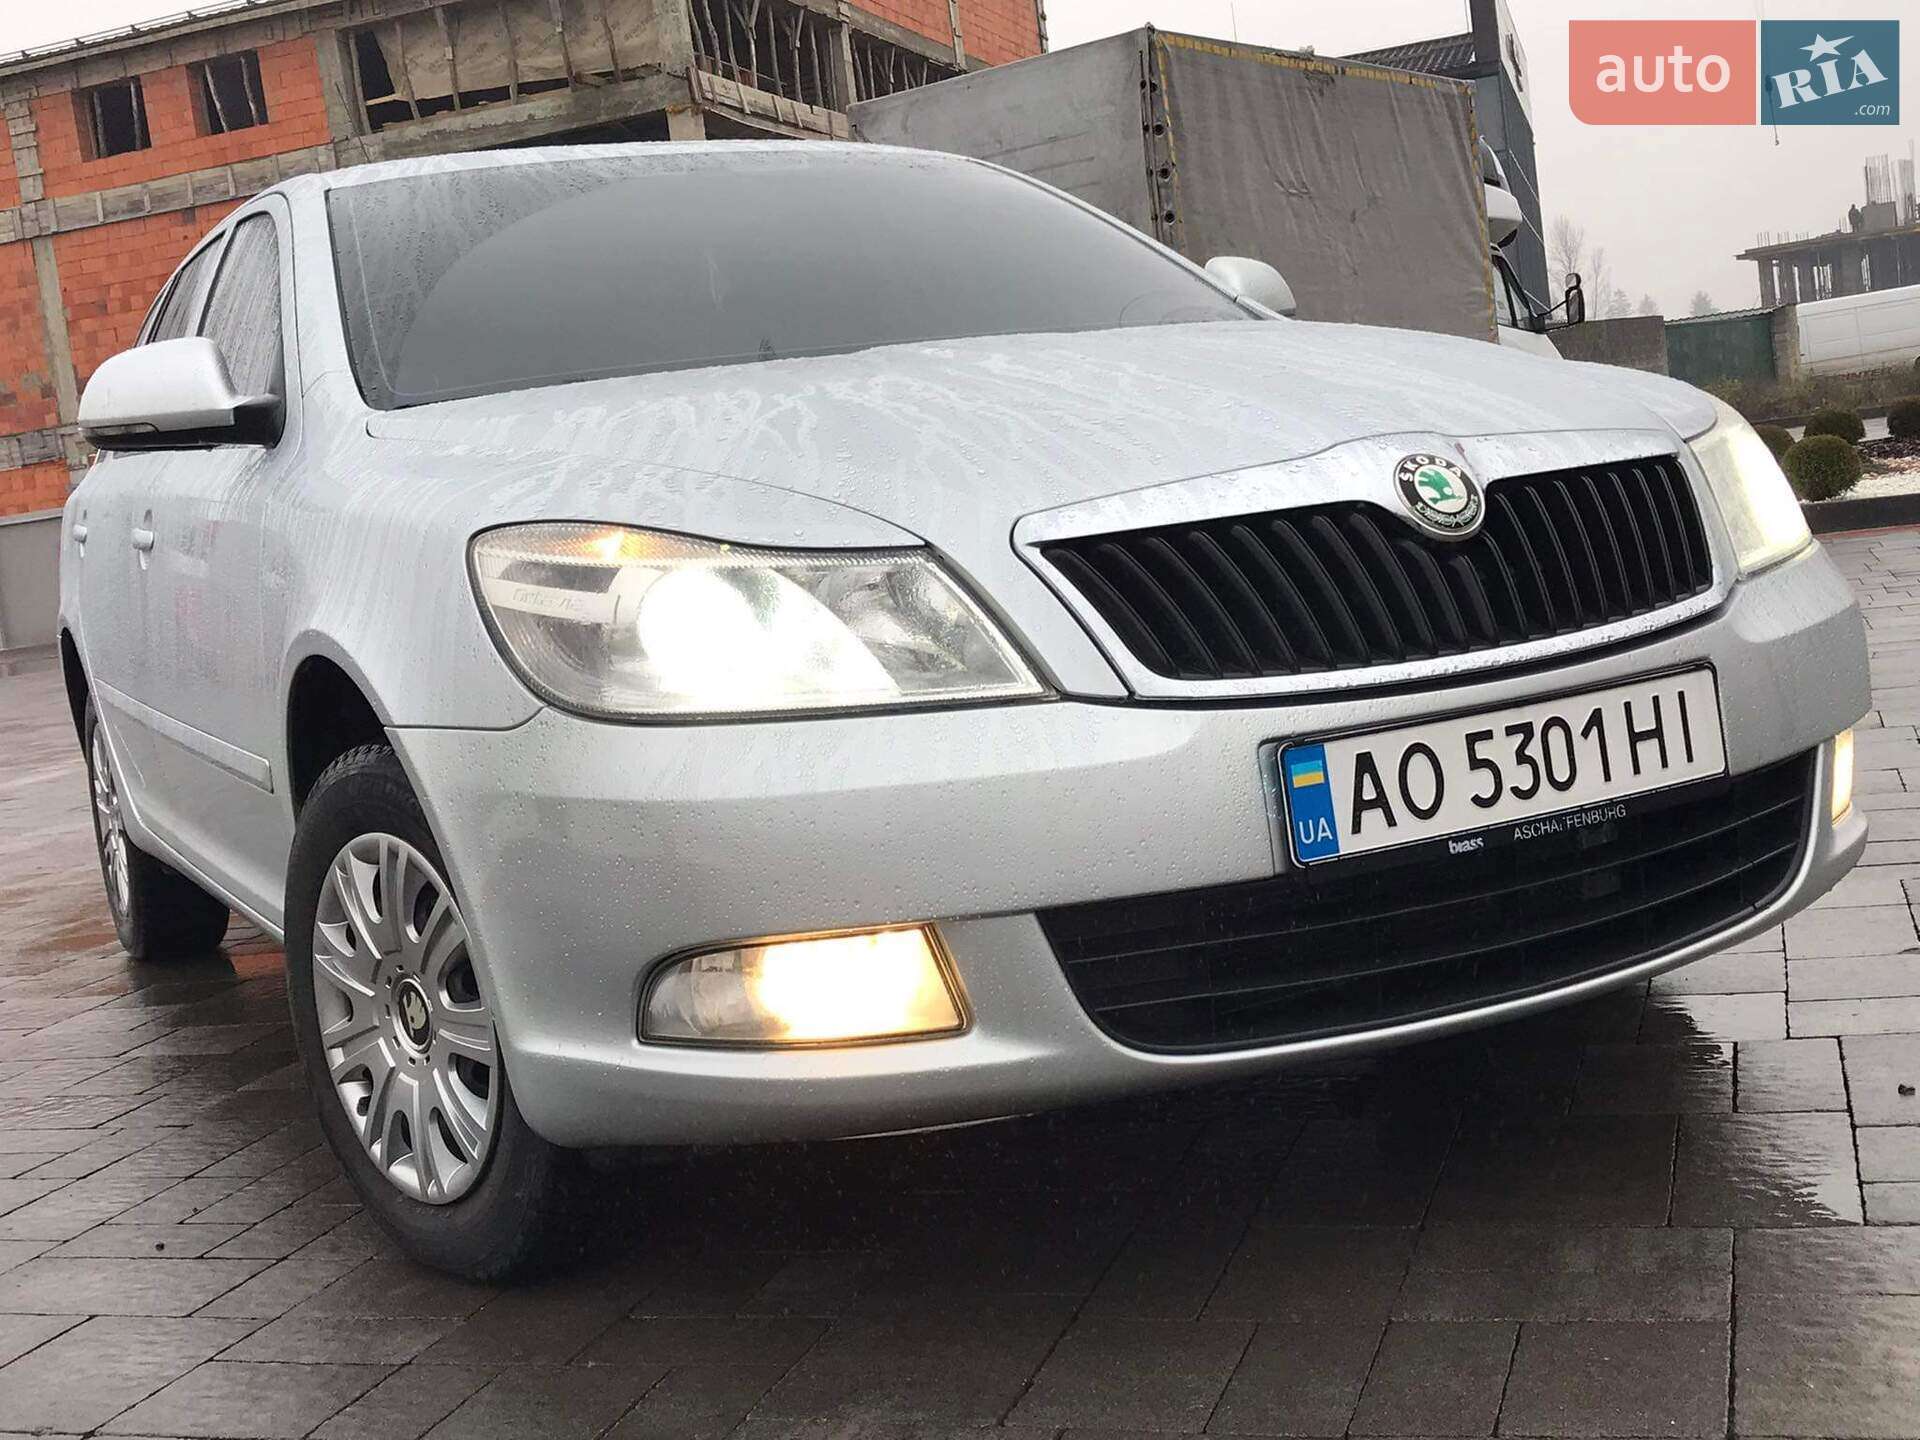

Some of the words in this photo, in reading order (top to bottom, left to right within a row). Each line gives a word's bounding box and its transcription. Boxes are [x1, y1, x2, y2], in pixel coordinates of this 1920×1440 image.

[1350, 742, 1444, 835] AO
[1465, 707, 1613, 809] 5301
[1623, 689, 1695, 776] HI
[1299, 821, 1334, 845] UA
[1513, 803, 1627, 841] ASCHAFENBURG
